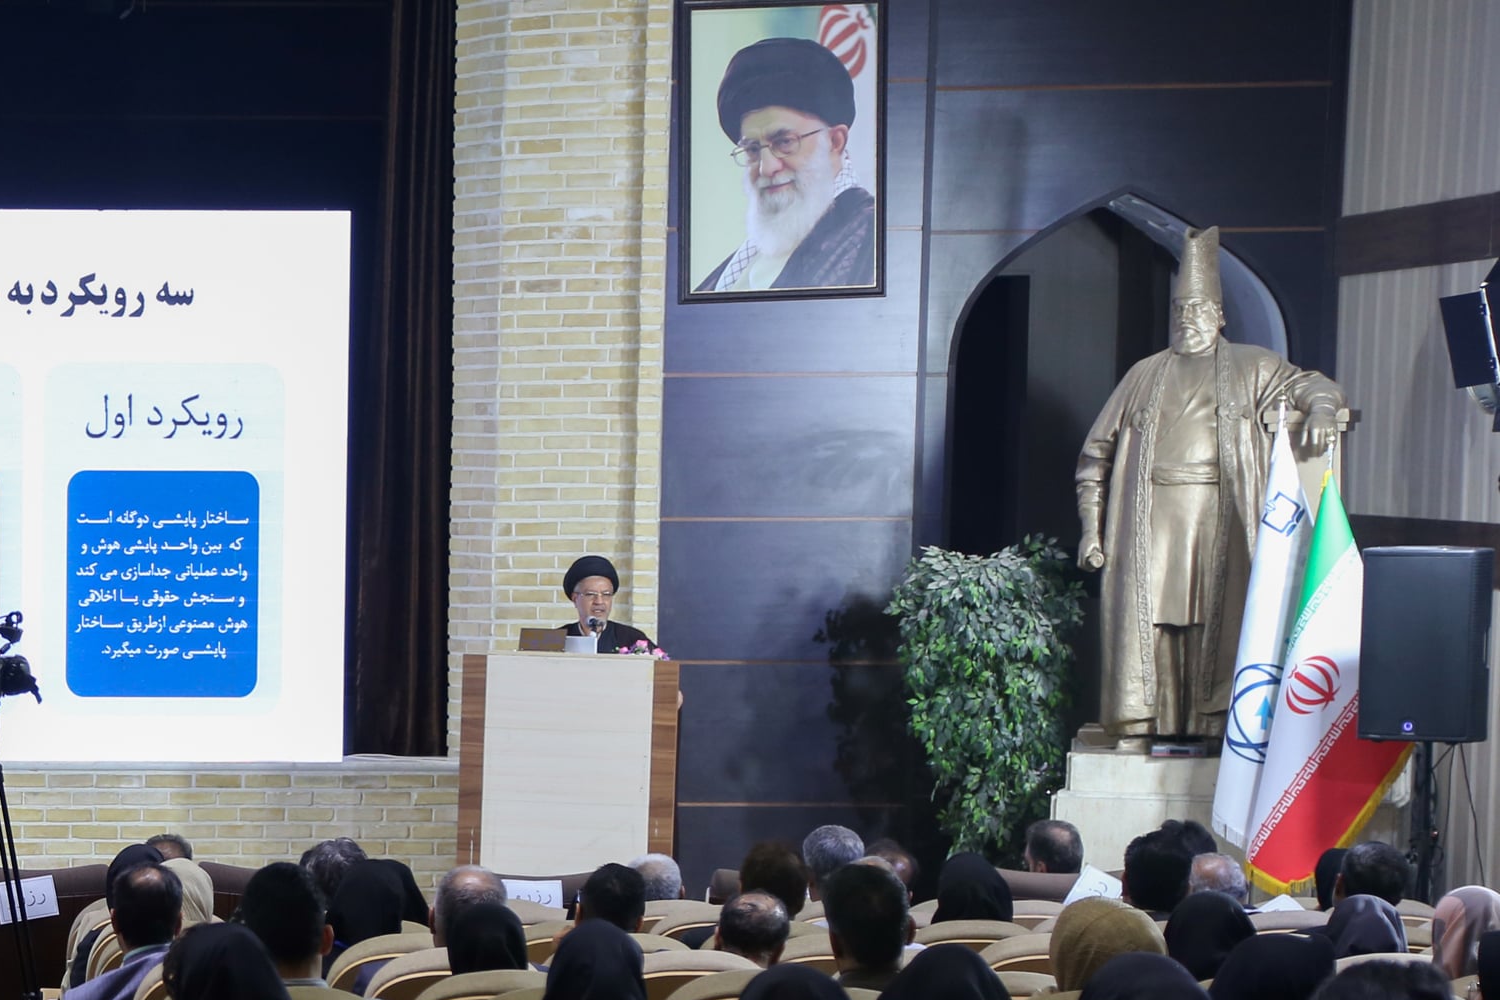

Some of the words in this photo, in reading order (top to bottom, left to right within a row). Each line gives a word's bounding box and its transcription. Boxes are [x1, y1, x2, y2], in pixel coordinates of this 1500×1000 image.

[156, 282, 193, 305] سه
[86, 394, 132, 438] اول
[148, 395, 243, 439] رویکرد
